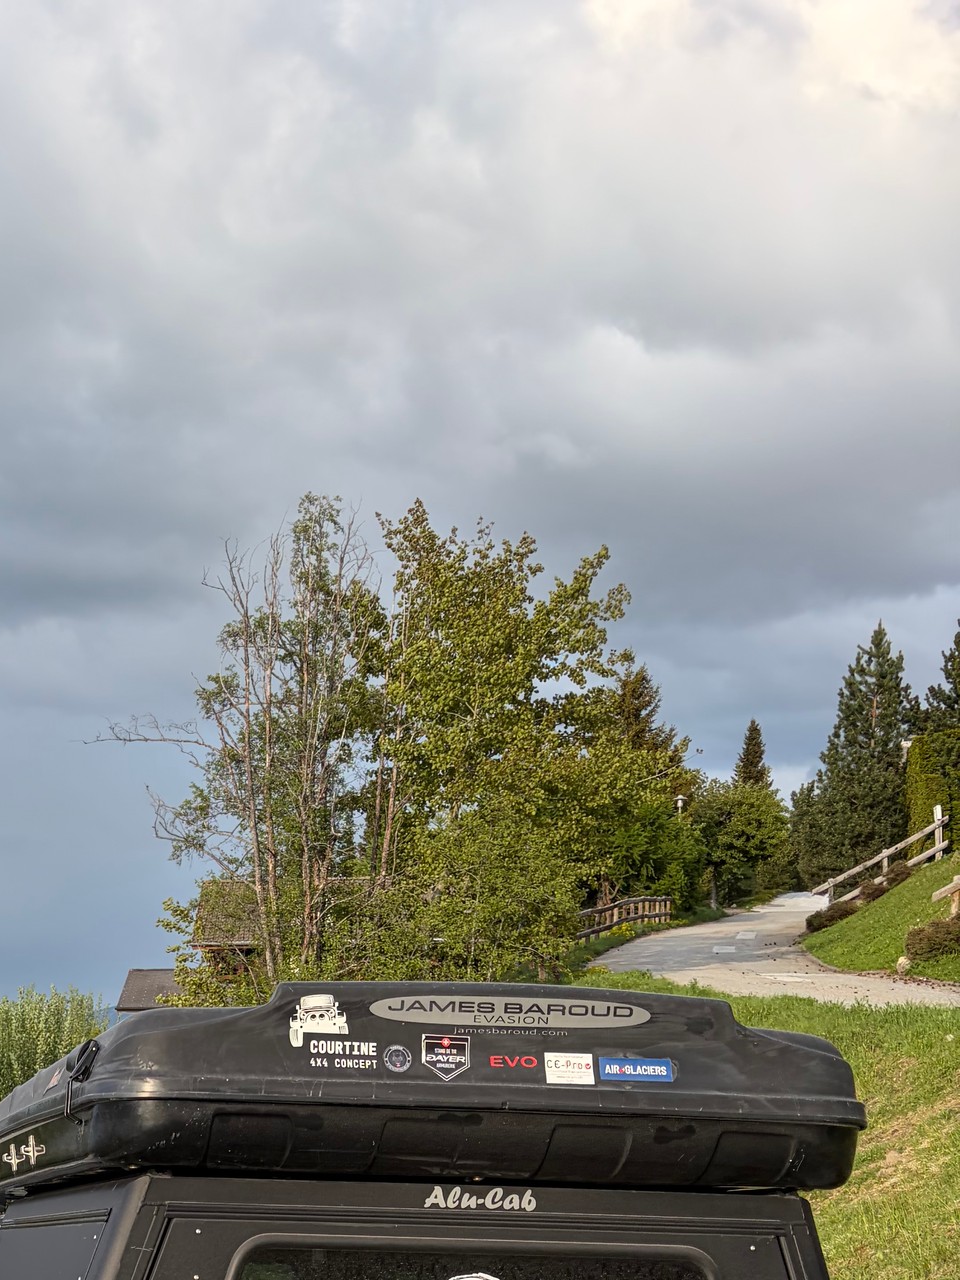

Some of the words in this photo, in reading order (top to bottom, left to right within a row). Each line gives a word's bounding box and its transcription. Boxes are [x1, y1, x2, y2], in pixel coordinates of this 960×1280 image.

[387, 999, 496, 1014] JAMES
[503, 1002, 634, 1018] BAROUD
[473, 1014, 549, 1025] EVASION
[453, 1026, 568, 1037] jamesbaroud.com
[309, 1040, 378, 1056] COURTINE
[334, 1058, 378, 1069] CONCEPT
[426, 1054, 466, 1063] DAYER
[489, 1055, 538, 1069] EVO
[423, 1185, 537, 1212] Alu-Cab
